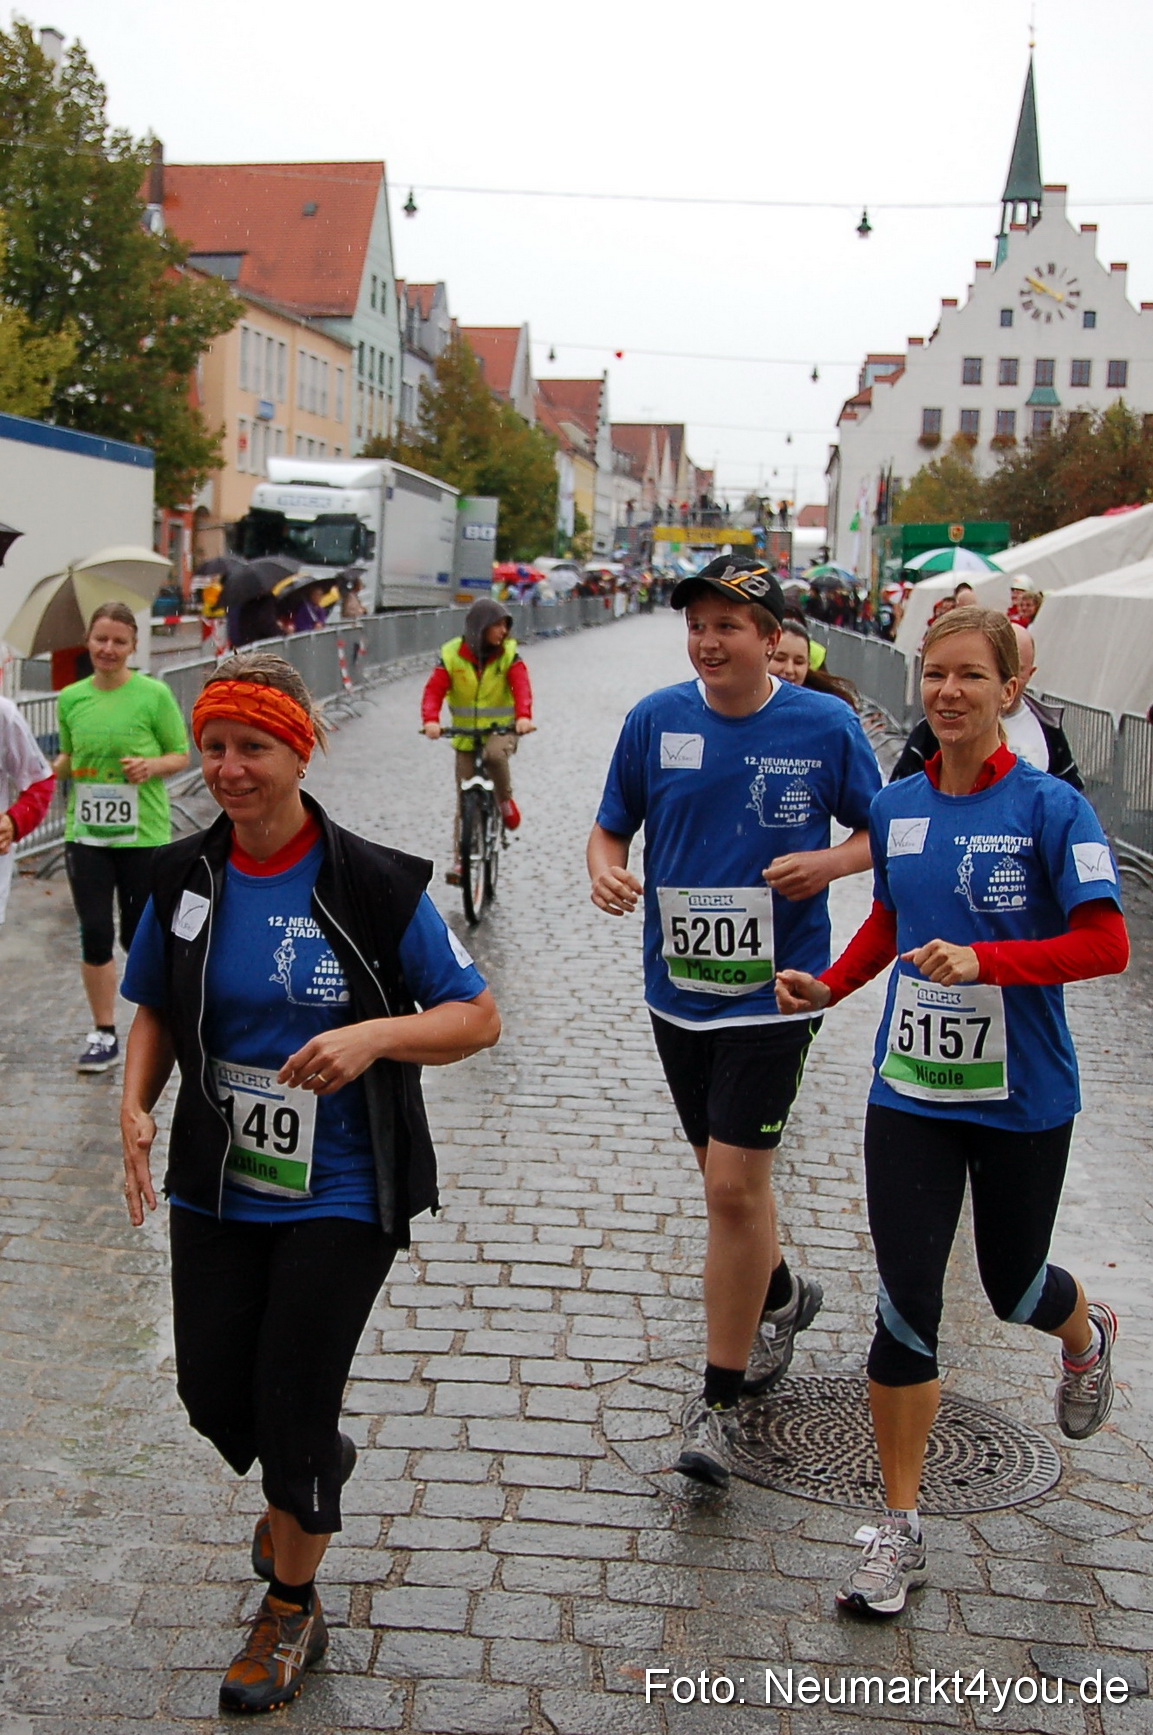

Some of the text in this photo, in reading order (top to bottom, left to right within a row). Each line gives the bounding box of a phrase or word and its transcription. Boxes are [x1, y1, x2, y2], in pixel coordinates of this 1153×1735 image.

[744, 756, 822, 768] 12. NEUMARKTER
[758, 766, 810, 775] STADTLAUF
[81, 800, 131, 823] 5129
[953, 835, 1033, 847] 12. NEUMARKTER
[966, 844, 1020, 854] STADTLAUF
[987, 885, 1026, 893] 18.09.2011
[689, 895, 733, 906] BOCK
[267, 916, 286, 927] 12.
[671, 916, 762, 957] 5204
[685, 959, 747, 984] Marco
[917, 988, 961, 1005] BOCK
[898, 1008, 992, 1060] 5157
[916, 1063, 964, 1086] Nicole
